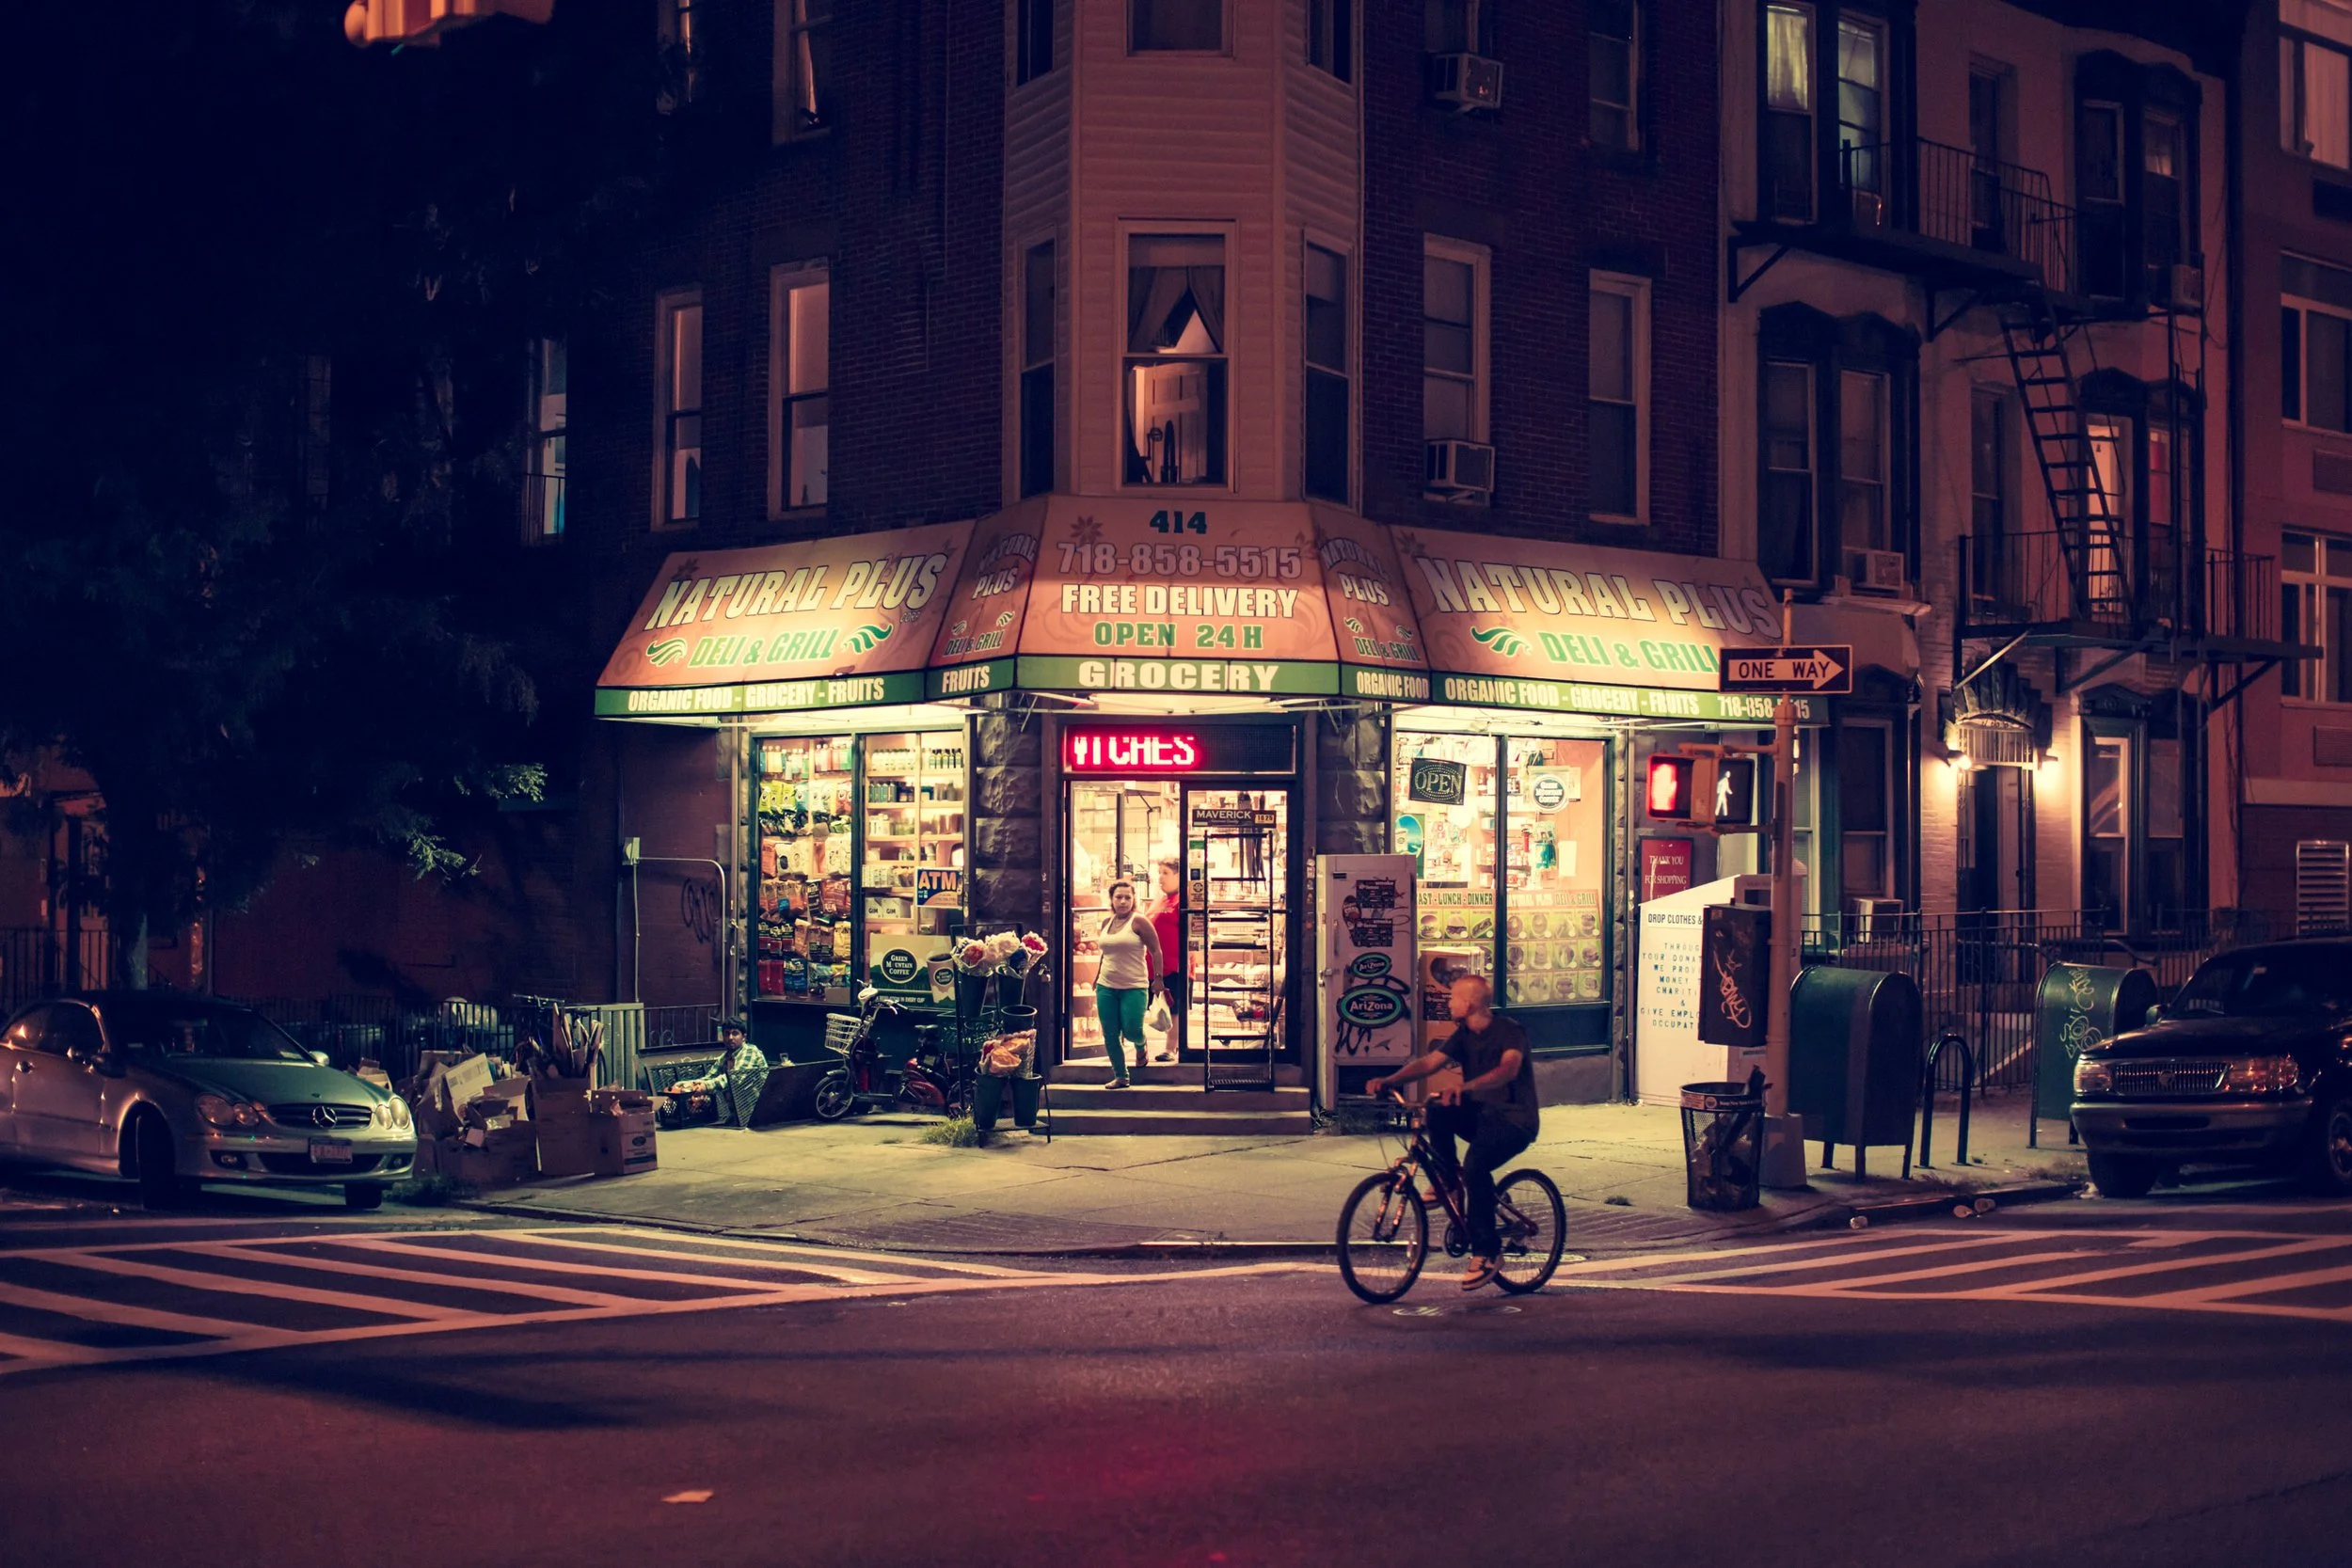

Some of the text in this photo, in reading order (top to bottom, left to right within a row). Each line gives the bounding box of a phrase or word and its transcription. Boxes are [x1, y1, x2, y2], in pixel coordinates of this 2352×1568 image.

[1149, 510, 1208, 534] 414
[1057, 542, 1303, 579] 718-858-5515
[644, 552, 948, 631] NATURAL PLUS
[972, 567, 1018, 600] PLUS
[1337, 572, 1390, 607] PLUS
[1060, 583, 1299, 618] FREE DELIVERY
[1415, 556, 1783, 640] NATURAL PLUS
[944, 629, 1005, 656] DELI & GRILL
[1093, 622, 1177, 647] OPEN
[688, 628, 840, 668] DELI & GRILL
[1353, 636, 1422, 662] DELI & GRILL
[1537, 630, 1611, 667] DELI
[1611, 642, 1640, 669] &
[942, 665, 990, 693] FRUITS
[1079, 661, 1279, 690] GROCERY
[1739, 661, 1831, 679] ONE WAY
[628, 687, 692, 712] ORGANIC
[693, 685, 733, 710] FOOD
[745, 681, 817, 709] GROCERY
[827, 677, 884, 703] FRUITS
[1356, 670, 1430, 700] ORGANIC FOOD
[1444, 677, 1517, 705] ORGANIC
[1518, 682, 1560, 707] FOOD
[1570, 686, 1640, 715] GROCERY
[1648, 691, 1700, 716] FRUITS
[1717, 696, 1810, 720] 718-858-15
[1414, 771, 1463, 795] OPEN
[1197, 810, 1251, 819] MAVERICK
[1649, 855, 1684, 865] THANK YOU
[918, 871, 957, 890] ATM
[1645, 875, 1687, 884] FOR SHOPPING
[1438, 893, 1462, 905] LUNCH
[1468, 893, 1493, 905] DINNER
[1577, 893, 1596, 905] GRILL
[1648, 913, 1666, 924] DROP
[1667, 914, 1696, 925] CLOTHES
[1660, 975, 1688, 984] MONEY
[1349, 1001, 1393, 1012] AriZona
[1641, 1007, 1663, 1016] GIVE
